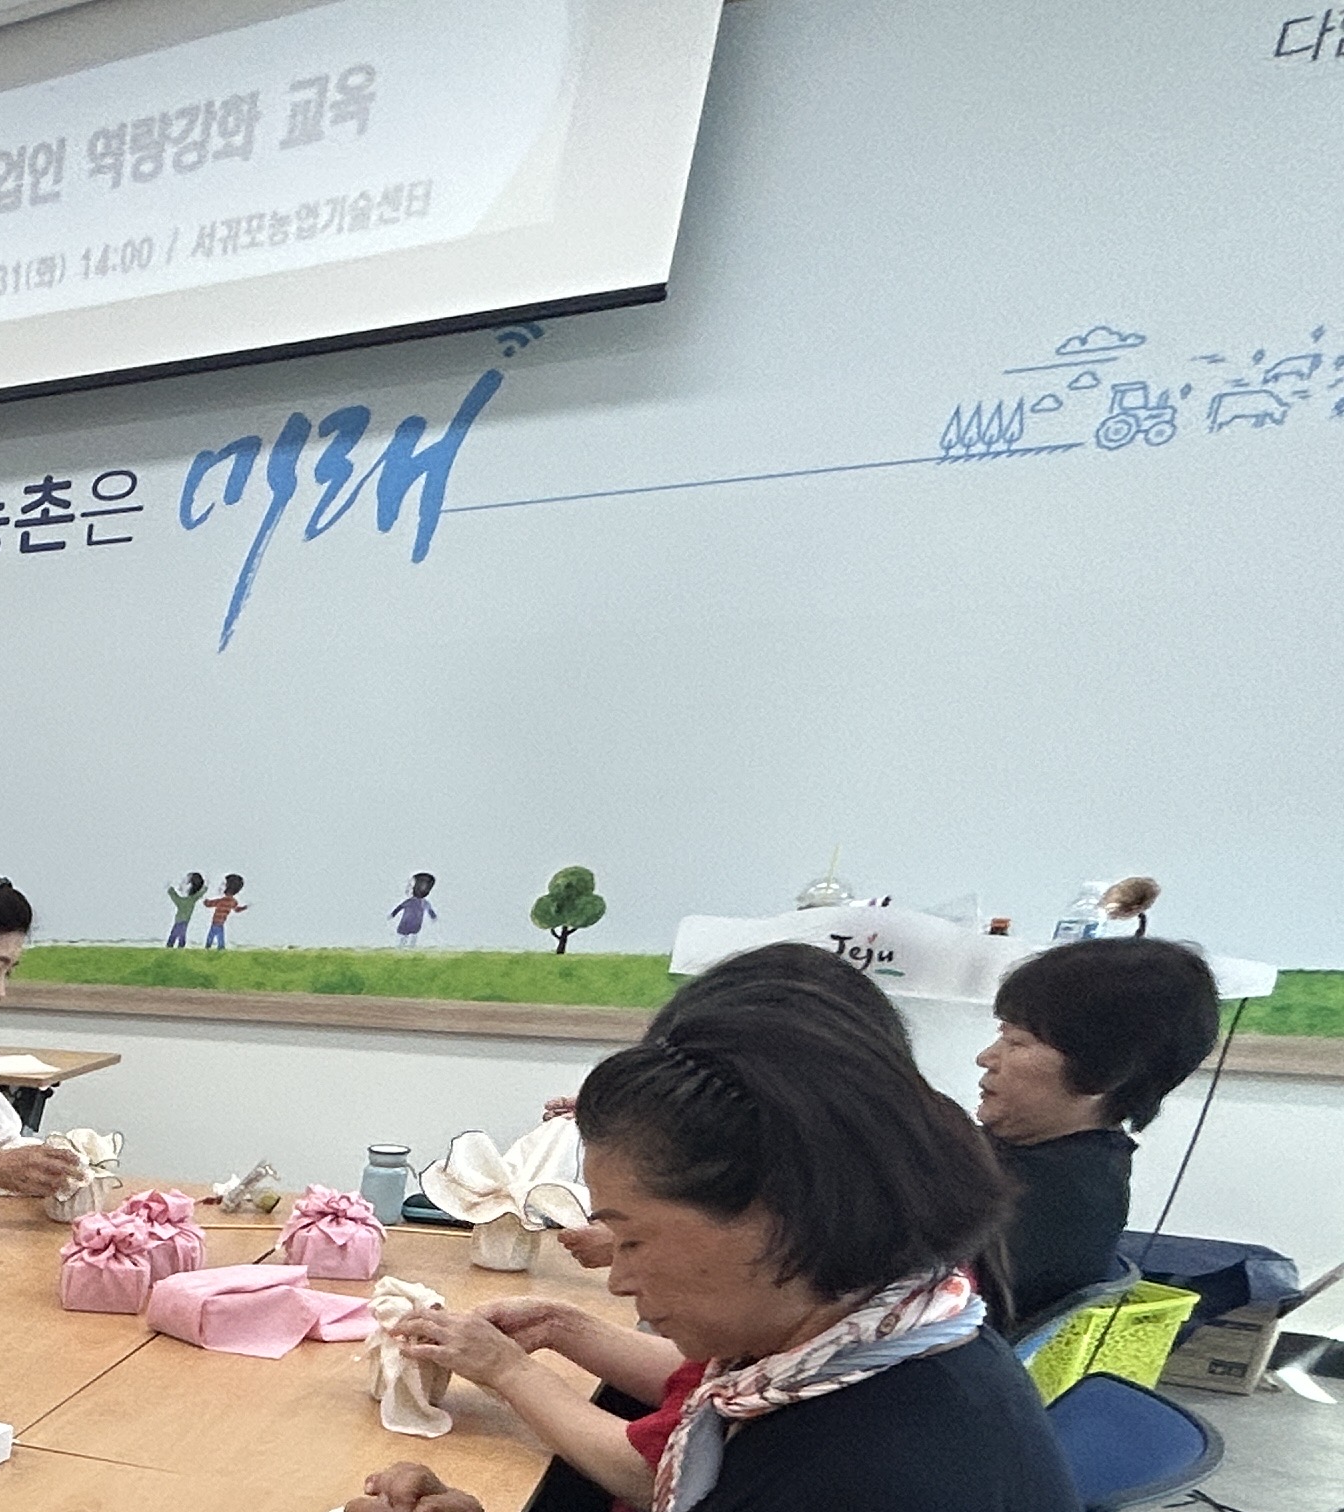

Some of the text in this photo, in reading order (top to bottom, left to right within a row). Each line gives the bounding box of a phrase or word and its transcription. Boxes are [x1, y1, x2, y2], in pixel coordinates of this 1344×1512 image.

[1274, 8, 1344, 61] 다
[86, 88, 261, 190] 역량강화
[278, 63, 377, 151] 교육
[80, 235, 155, 280] 14:00
[190, 177, 434, 258] 서귀포농업기술센터
[179, 368, 504, 654] 미래
